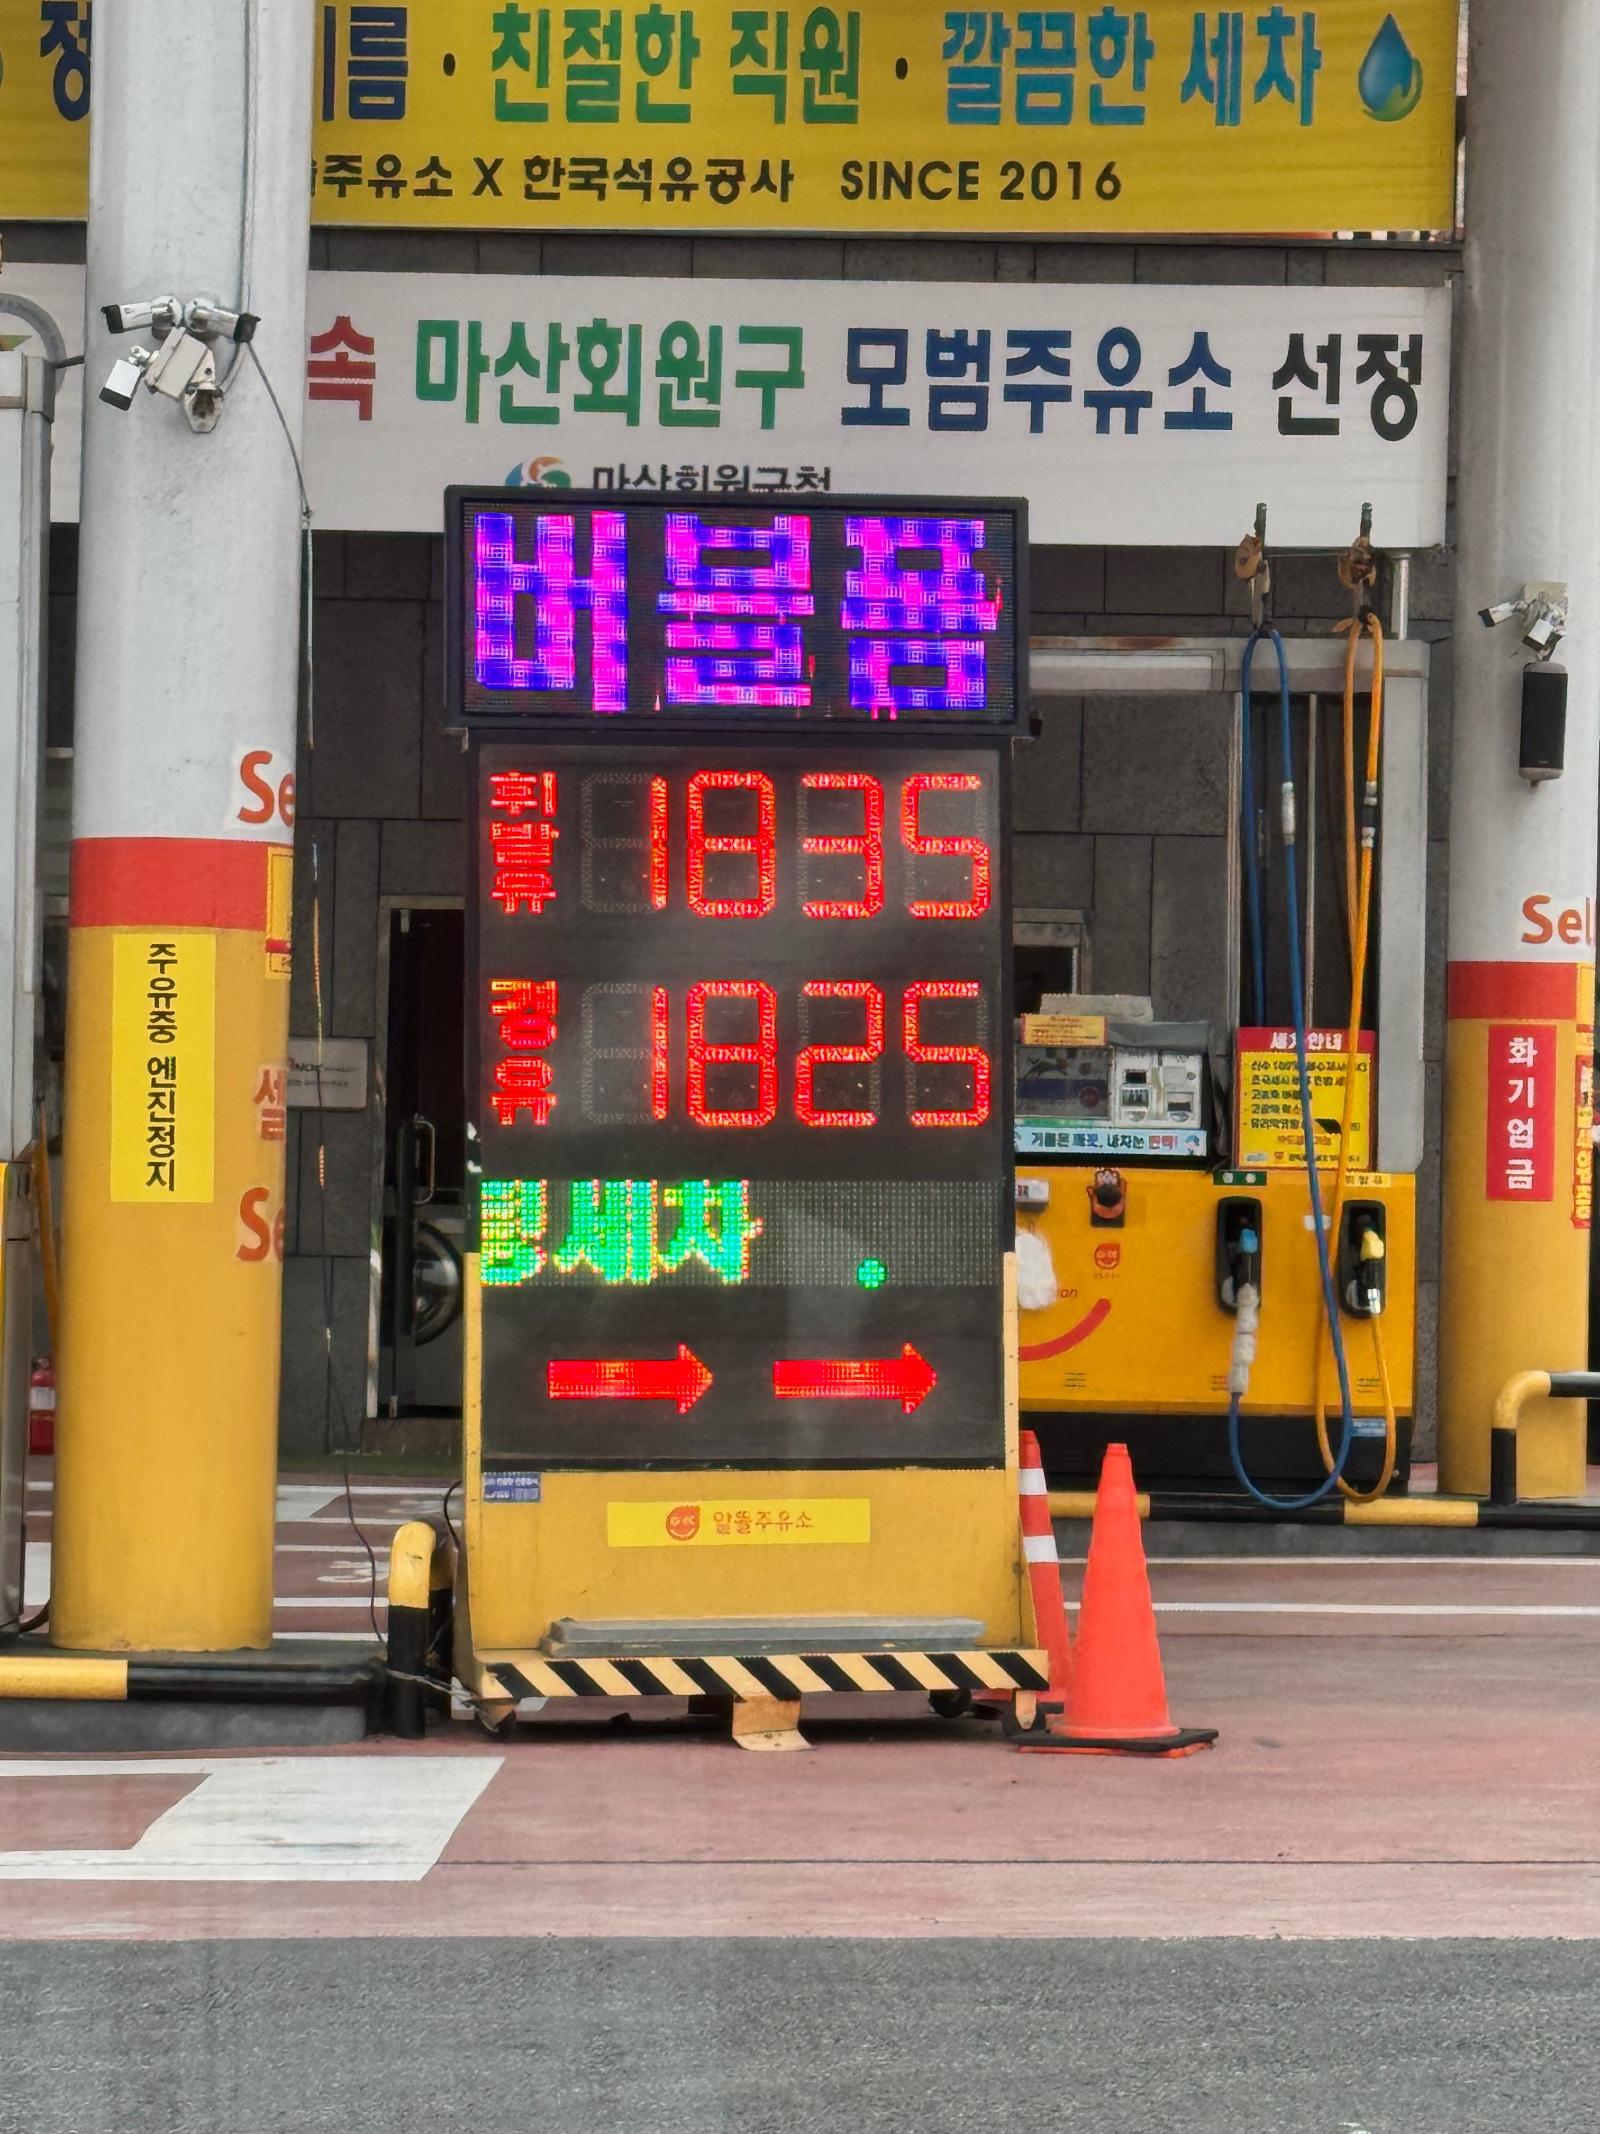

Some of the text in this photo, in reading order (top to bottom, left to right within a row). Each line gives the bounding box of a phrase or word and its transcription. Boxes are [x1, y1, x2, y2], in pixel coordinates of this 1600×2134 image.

[492, 4, 700, 123] 친절한
[730, 9, 860, 125] 직원
[942, 7, 1154, 126] 깔끔한
[1180, 7, 1322, 127] 세차
[311, 153, 1122, 204] 주유소 X 한국석유공사 SINCE 2016
[415, 317, 806, 430] 마산회원구
[841, 326, 1233, 436] 모범주유소
[1272, 332, 1424, 442] 선정
[490, 769, 991, 919] 휘발유 1835
[145, 943, 179, 1193] 주유중 엔진정지
[490, 978, 991, 1128] 경유 1825
[1505, 1036, 1538, 1191] 화기엄금
[713, 1510, 814, 1535] 알뜰주유소
